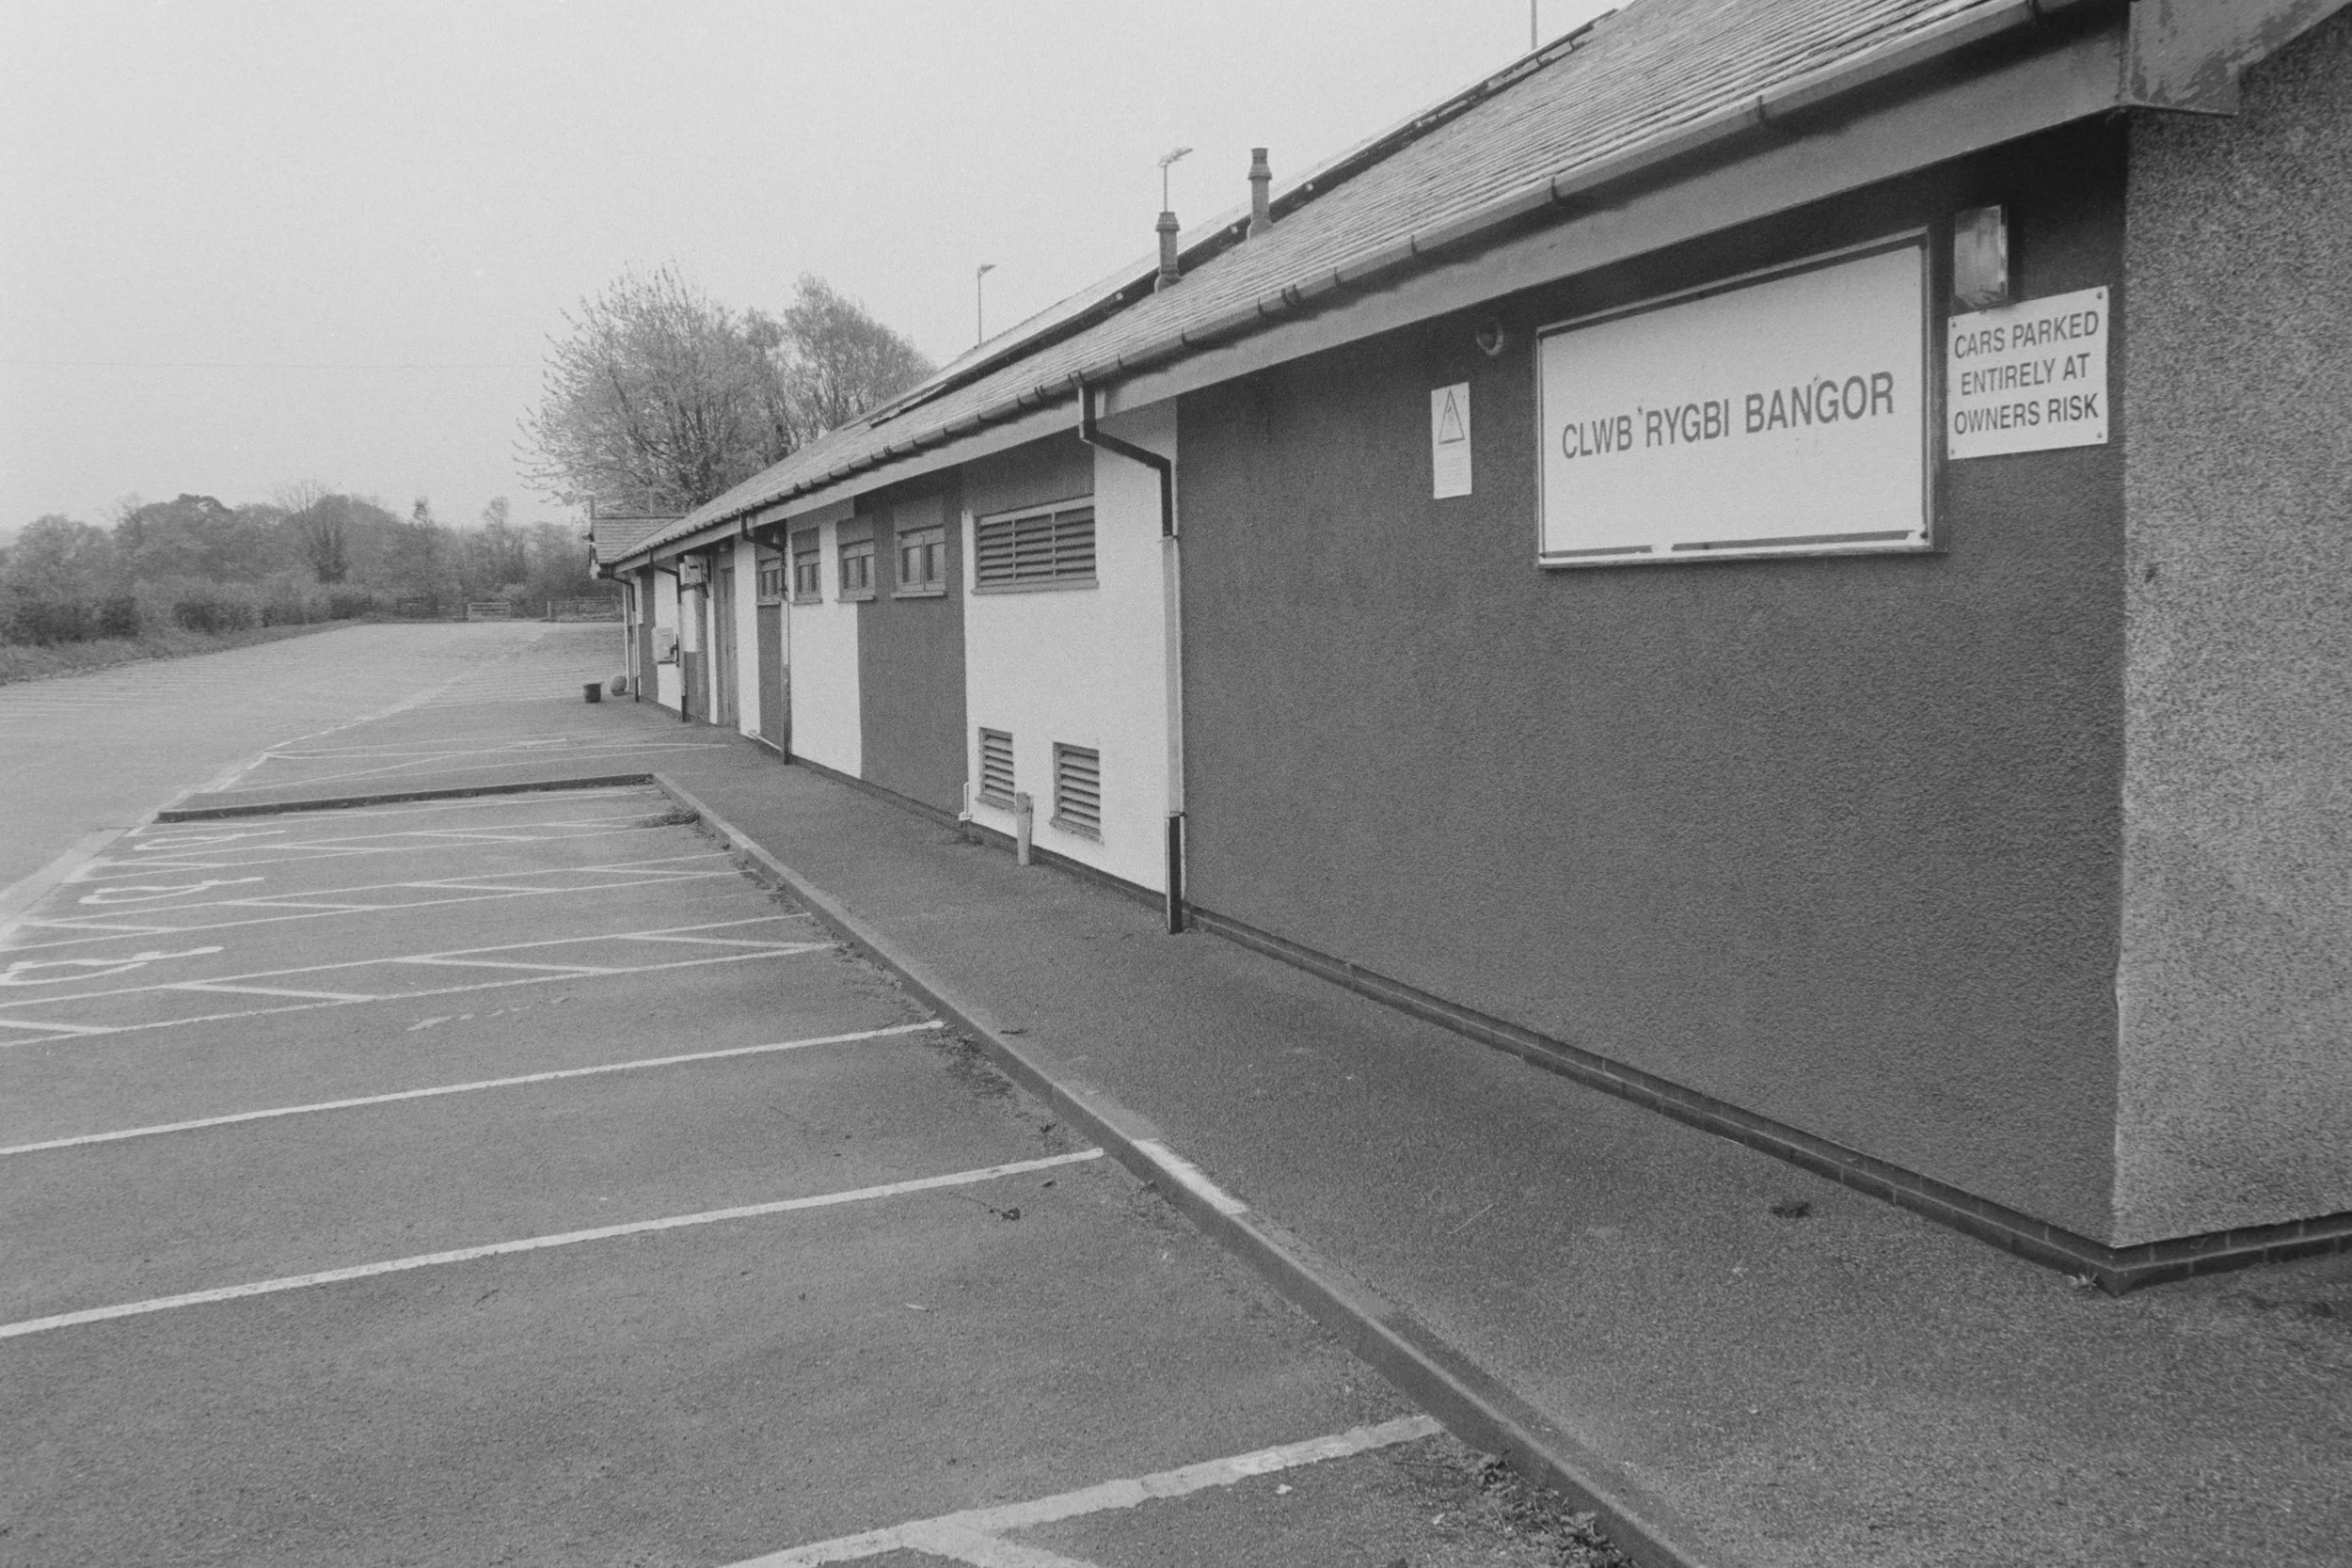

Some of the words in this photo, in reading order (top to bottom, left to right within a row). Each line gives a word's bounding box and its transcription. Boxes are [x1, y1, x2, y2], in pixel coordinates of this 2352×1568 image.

[1954, 327, 2006, 359] CARS
[2012, 310, 2099, 349] PARKED
[1961, 357, 2056, 396] ENTIRELY
[2062, 352, 2091, 381] AT
[1562, 415, 1632, 459] CLWB
[1646, 398, 1730, 447] RYGBI
[1746, 371, 1895, 434] BANGOR
[1954, 401, 2041, 435] OWNERS
[2047, 392, 2099, 423] RISK
